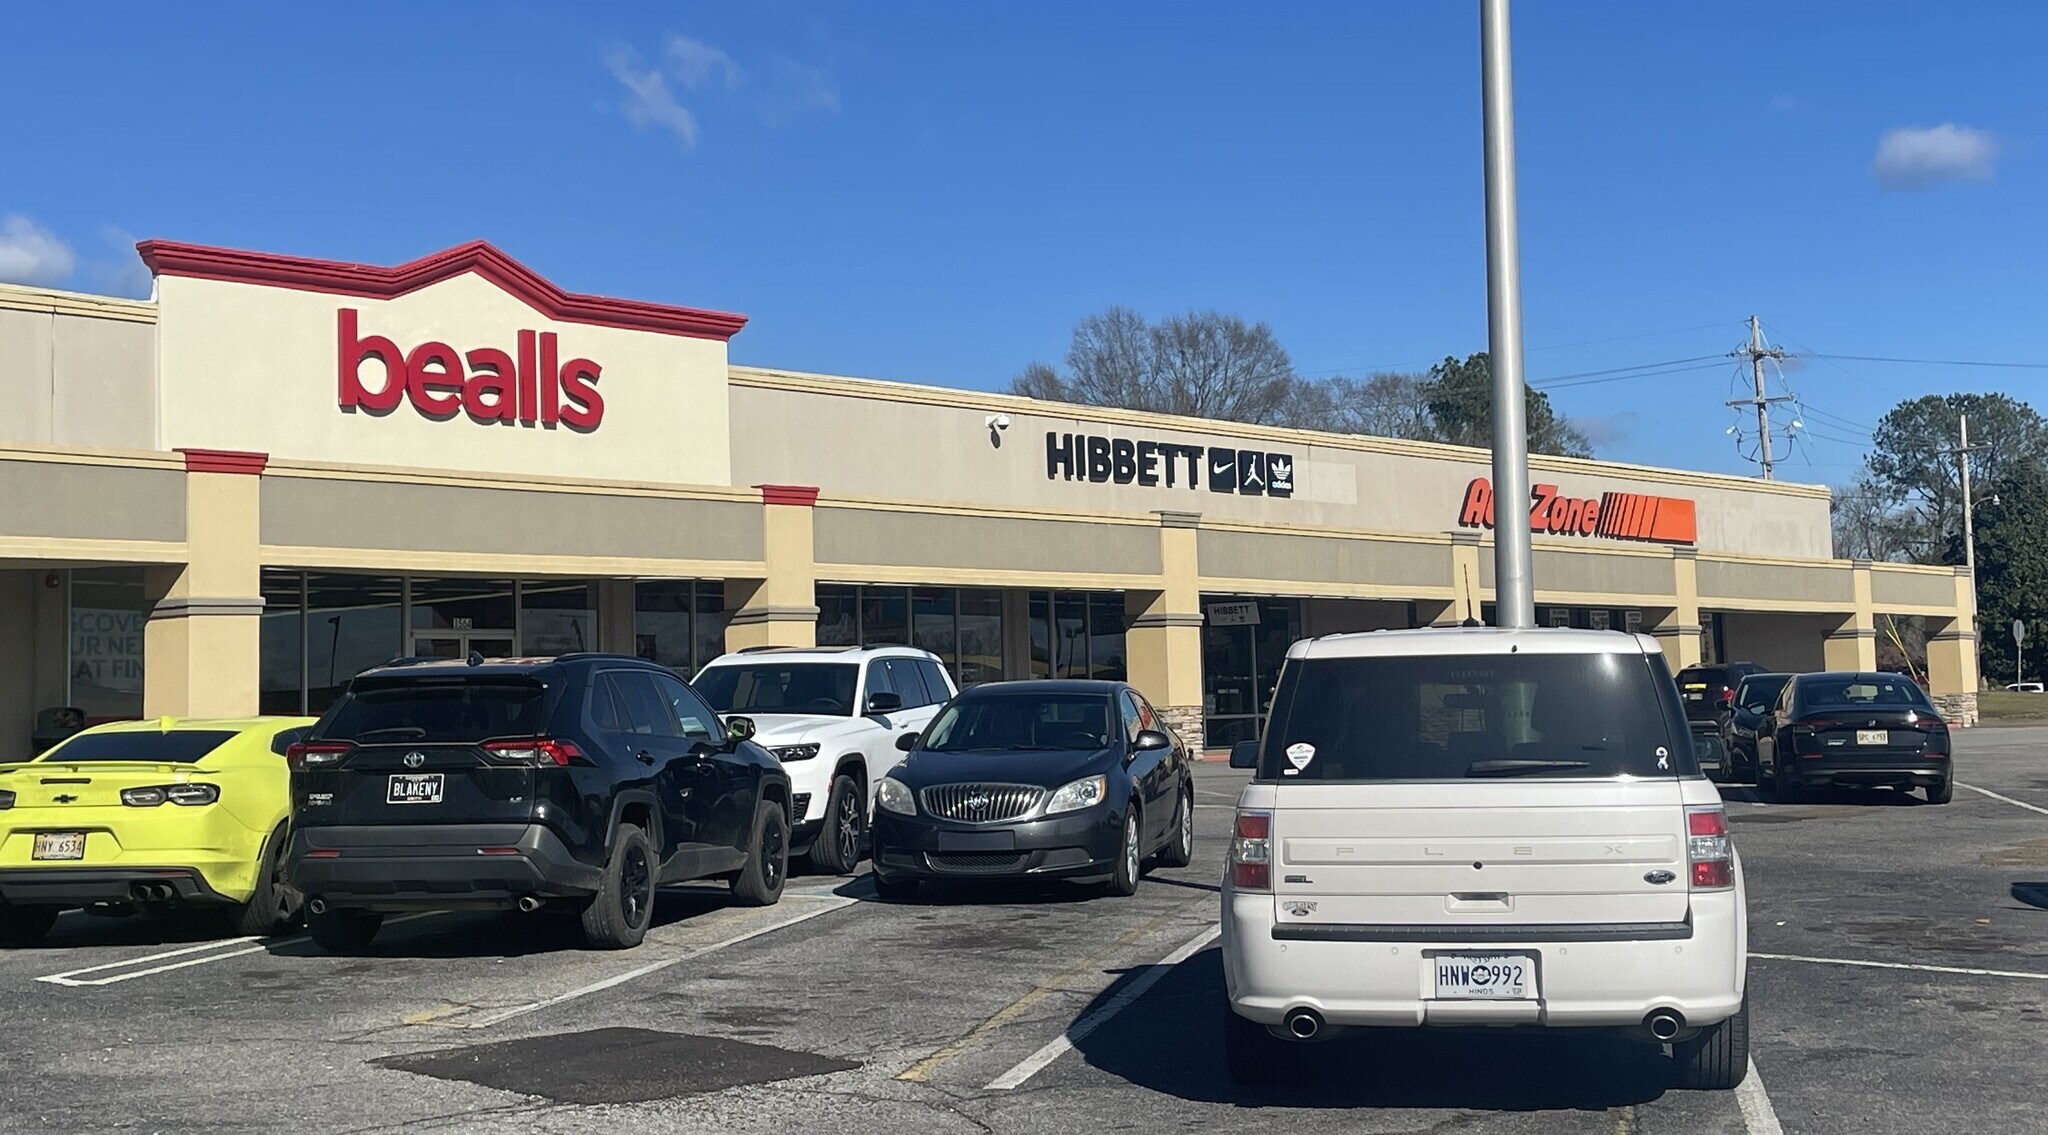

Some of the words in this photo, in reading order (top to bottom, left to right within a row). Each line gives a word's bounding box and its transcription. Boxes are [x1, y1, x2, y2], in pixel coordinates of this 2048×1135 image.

[338, 308, 604, 434] bealls
[1046, 432, 1204, 490] HIBBETT
[1458, 477, 1601, 538] AZone
[1213, 605, 1250, 615] HIBBETT
[394, 782, 438, 796] BLAKENY
[1439, 965, 1470, 986] HNW
[1491, 965, 1523, 986] 992
